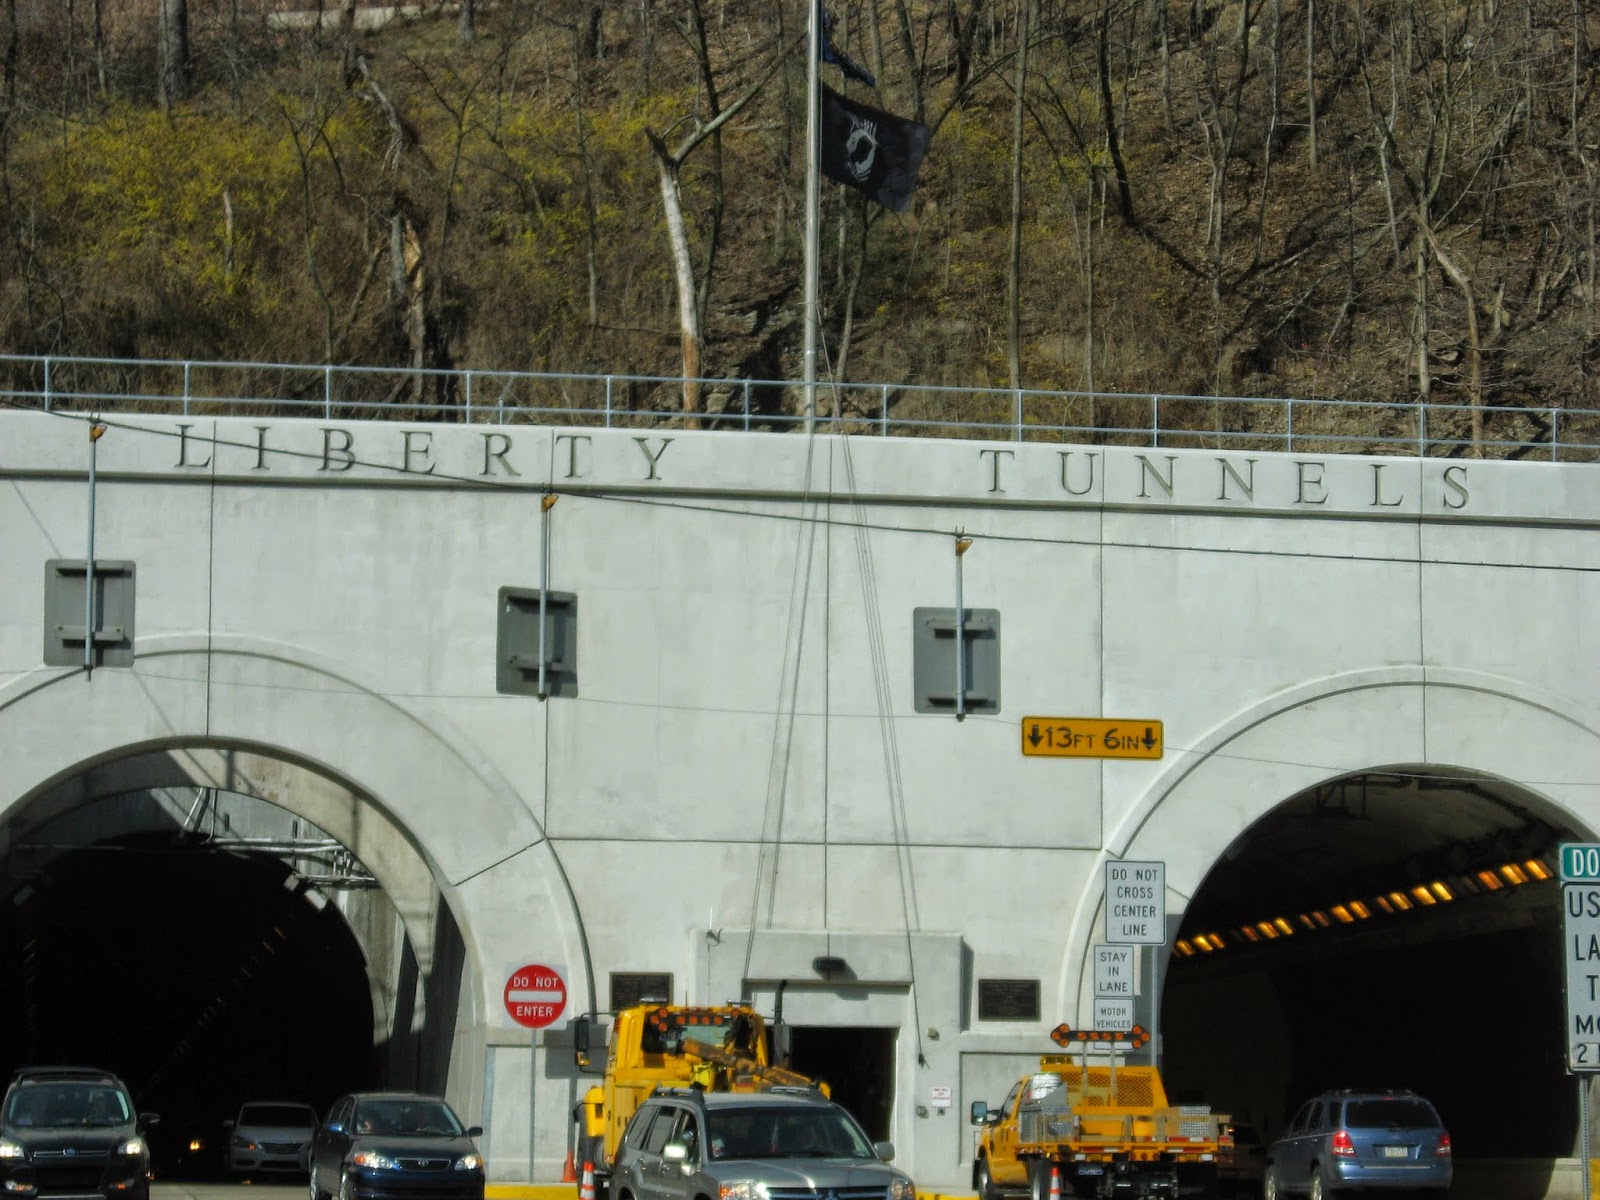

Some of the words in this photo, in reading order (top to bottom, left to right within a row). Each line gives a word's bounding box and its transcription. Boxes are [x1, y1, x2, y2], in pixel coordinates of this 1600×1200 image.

[174, 424, 676, 480] LIBERTY
[979, 449, 1470, 509] TUNNELS
[1112, 868, 1128, 881] DO
[1136, 869, 1158, 882] NOT
[1117, 886, 1154, 899] CROSS
[1114, 905, 1157, 918] CENTER
[1122, 924, 1148, 936] LINE
[1100, 952, 1128, 962] STAY
[1108, 966, 1120, 977] IN
[513, 976, 529, 988] DO
[535, 977, 559, 988] NOT
[1099, 982, 1129, 992] LANE
[516, 1005, 553, 1017] ENTER
[1100, 1007, 1127, 1017] MOTOR
[1096, 1020, 1132, 1029] VEHICLES
[1575, 1014, 1600, 1035] M
